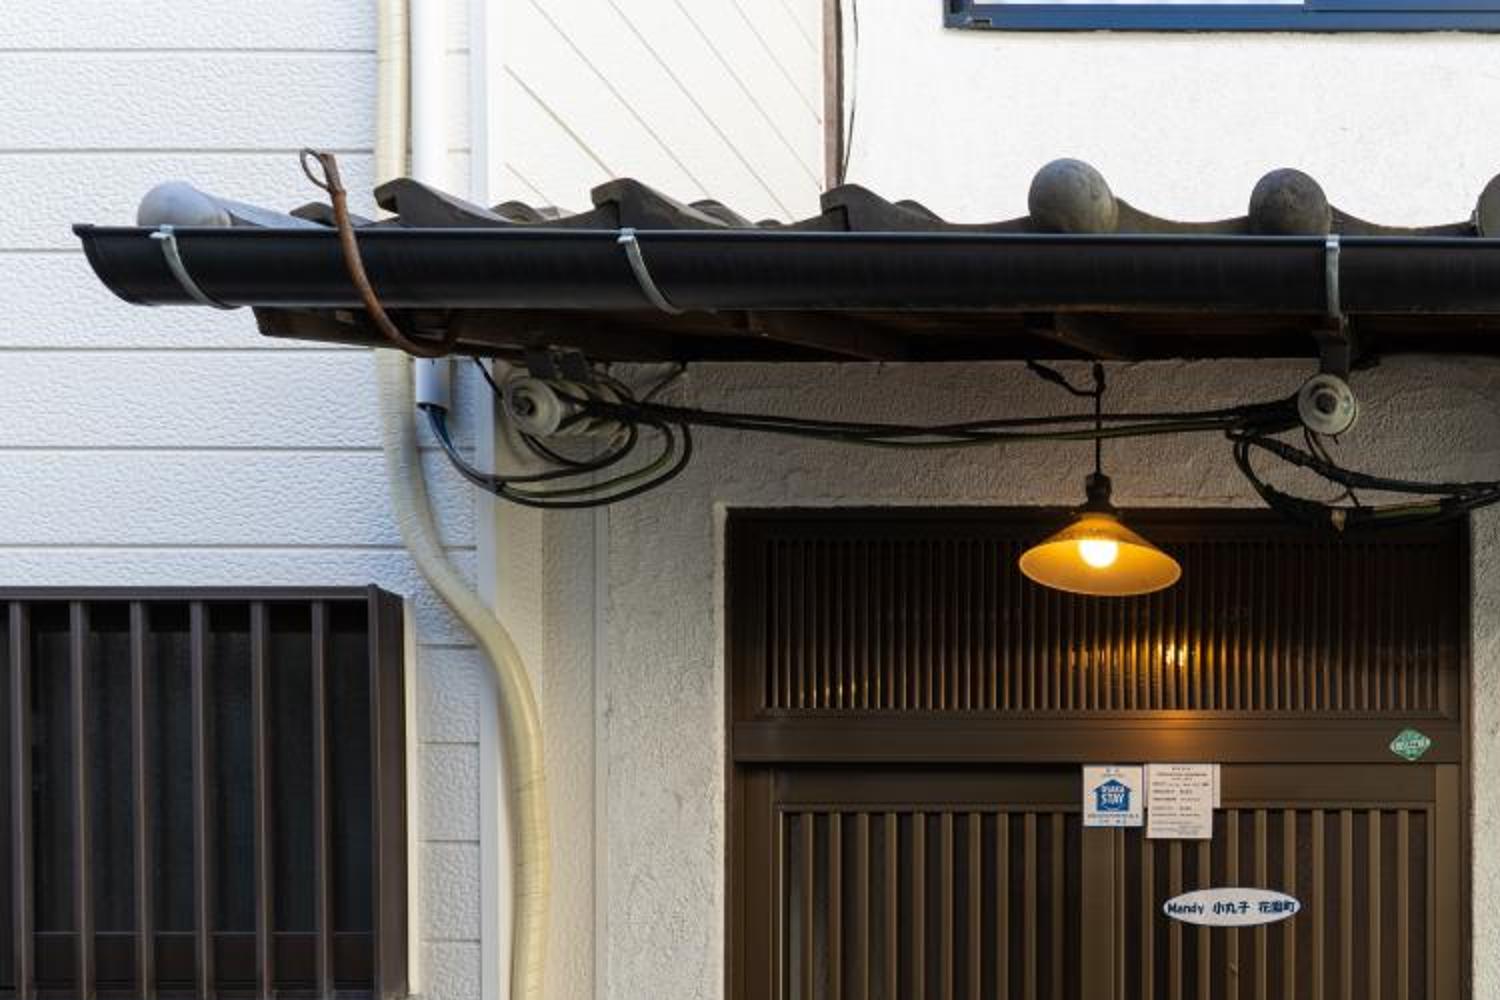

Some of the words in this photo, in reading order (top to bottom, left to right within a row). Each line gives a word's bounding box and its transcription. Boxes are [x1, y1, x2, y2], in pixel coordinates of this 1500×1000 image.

[1167, 902, 1204, 914] Mandy
[1213, 901, 1250, 914] 小丸子
